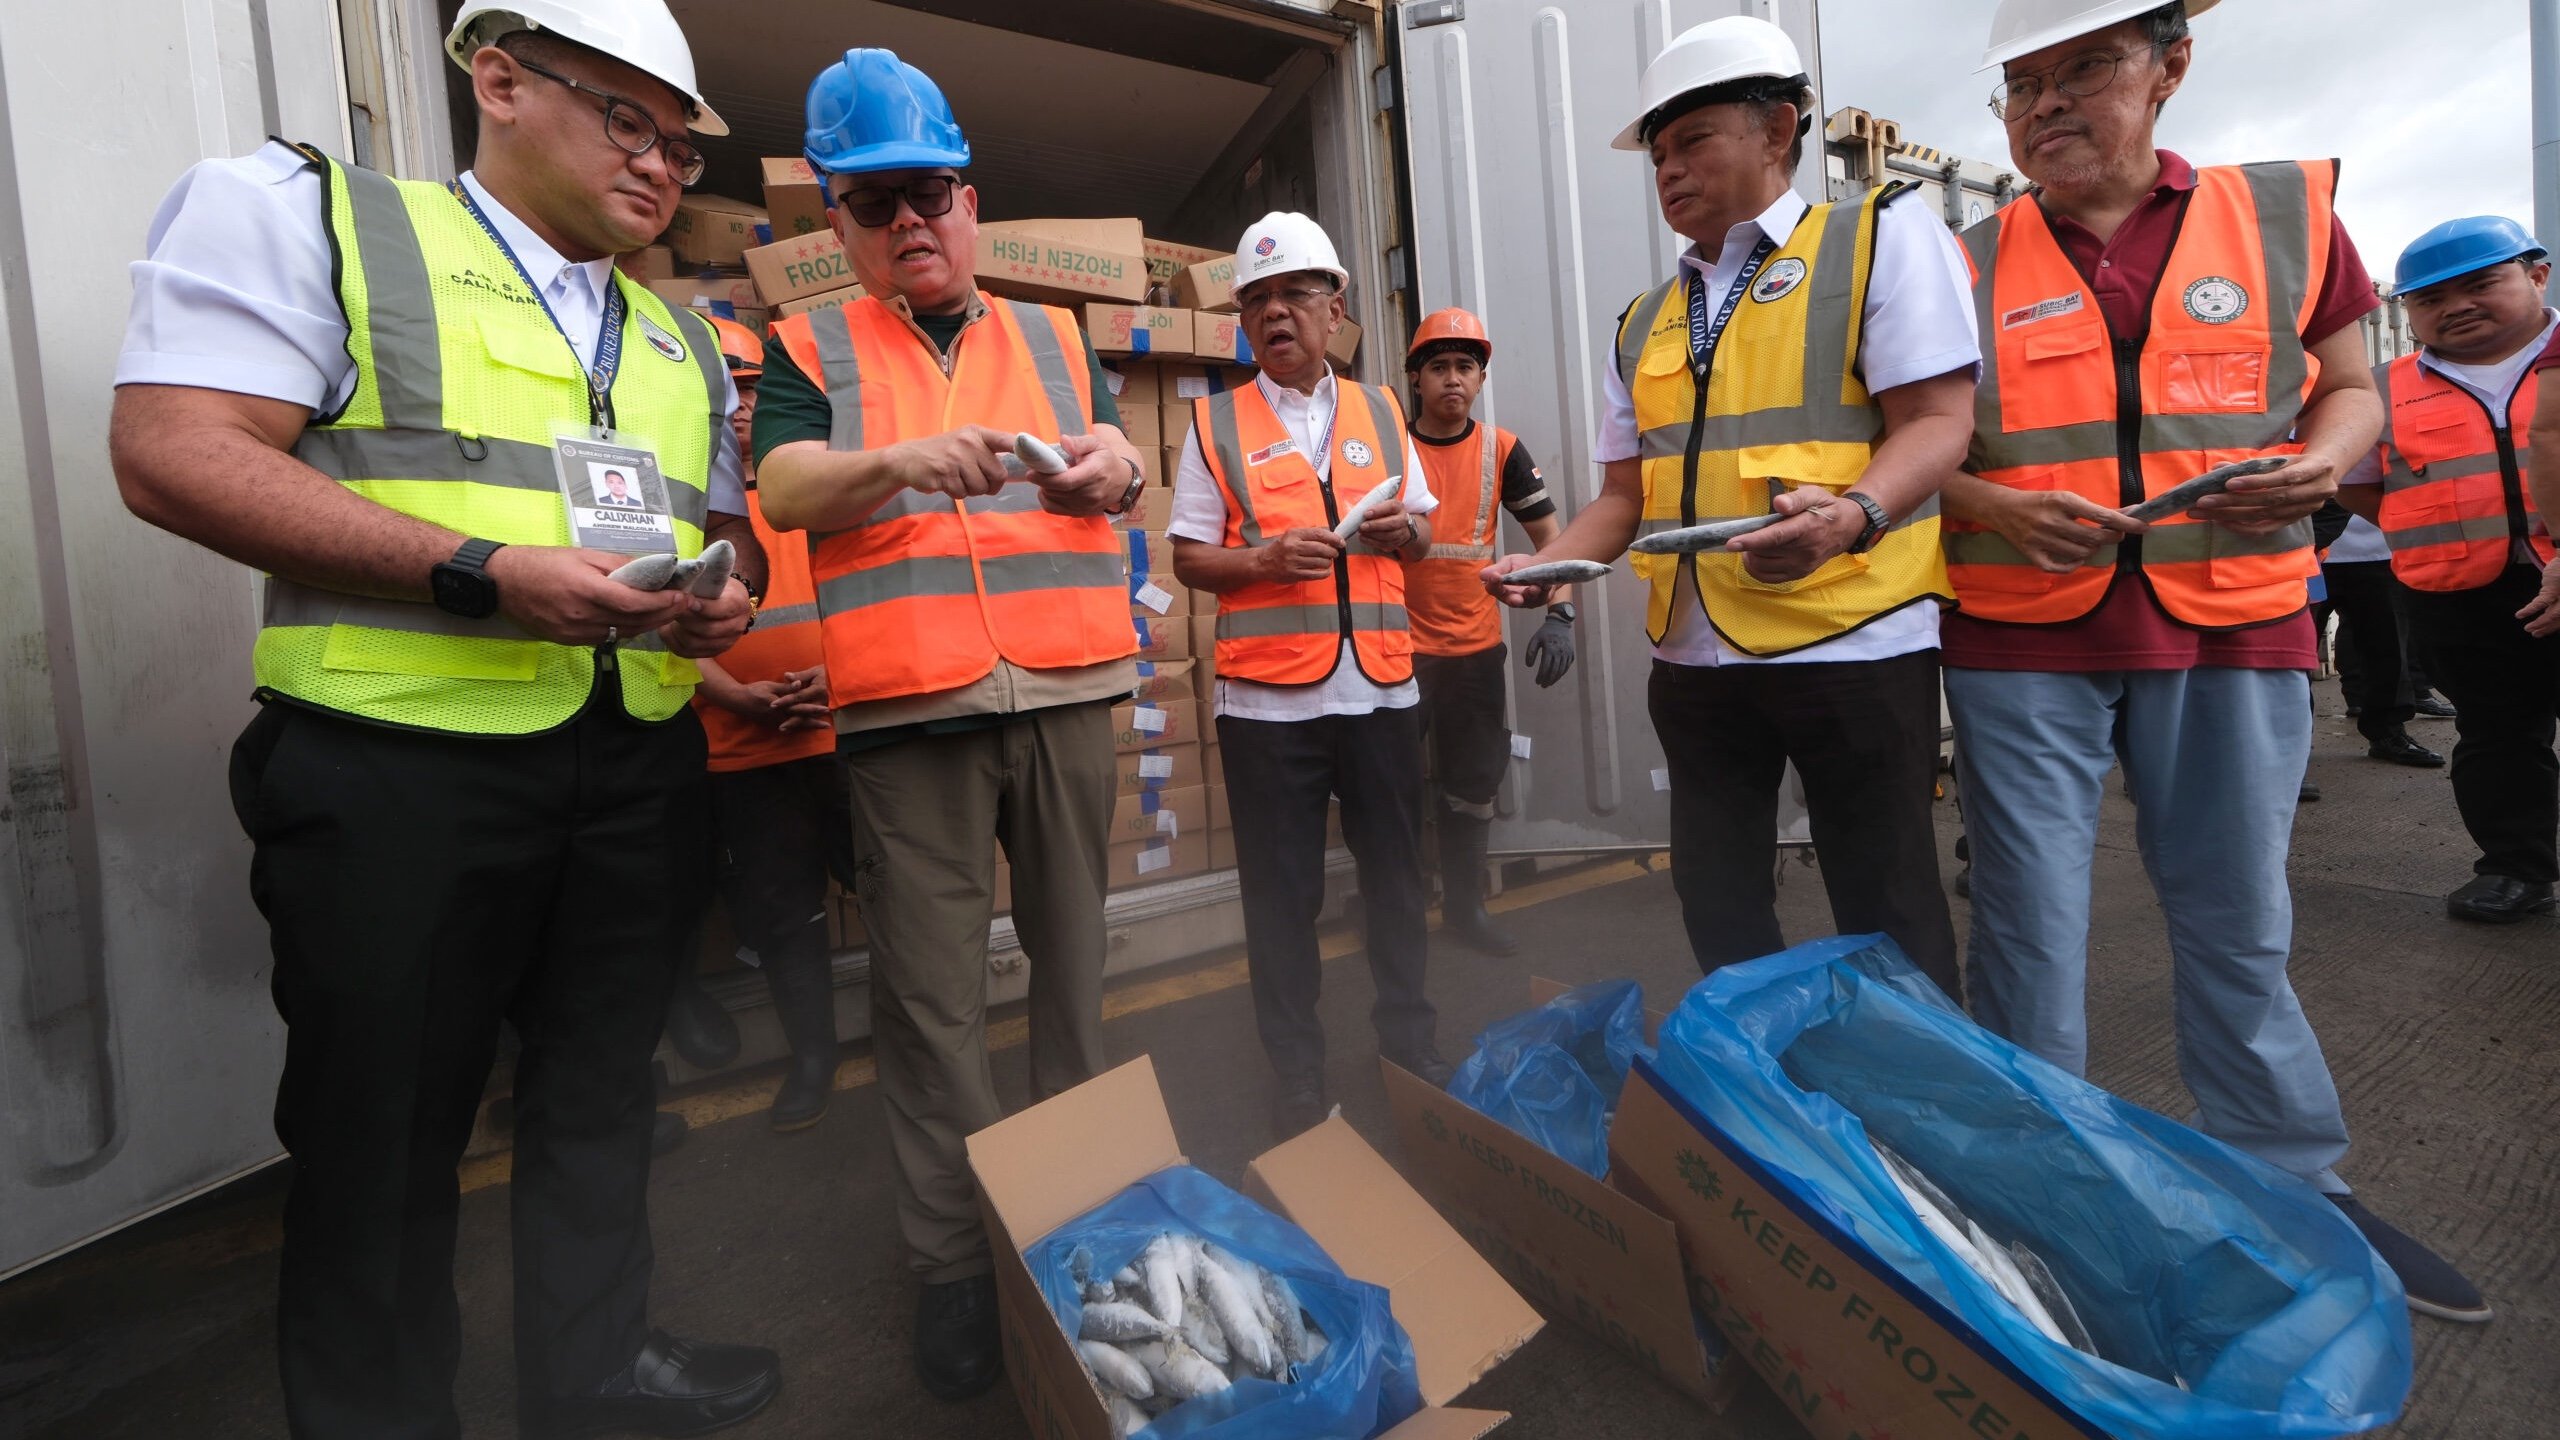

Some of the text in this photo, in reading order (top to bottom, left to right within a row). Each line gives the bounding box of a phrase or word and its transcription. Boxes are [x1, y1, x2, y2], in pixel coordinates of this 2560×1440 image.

[784, 252, 851, 288] FROZ
[993, 239, 1122, 279] FROZEN FISH
[1151, 258, 1181, 278] ZEN
[1207, 261, 1236, 284] ISH
[1706, 256, 1760, 349] BUREAU OF
[2039, 294, 2079, 310] SUBIC BAY
[1148, 313, 1173, 329] IQF
[1450, 314, 1463, 332] K
[1691, 293, 1705, 353] CUSTOMS
[601, 323, 620, 371] BUREAU
[594, 510, 655, 525] CALIXIHAN
[1116, 731, 1140, 745] IQF
[1456, 1128, 1629, 1254] KEEP FROZEN
[1730, 1198, 2030, 1440] KEEP FROZE
[1692, 1274, 1822, 1418] OZEN
